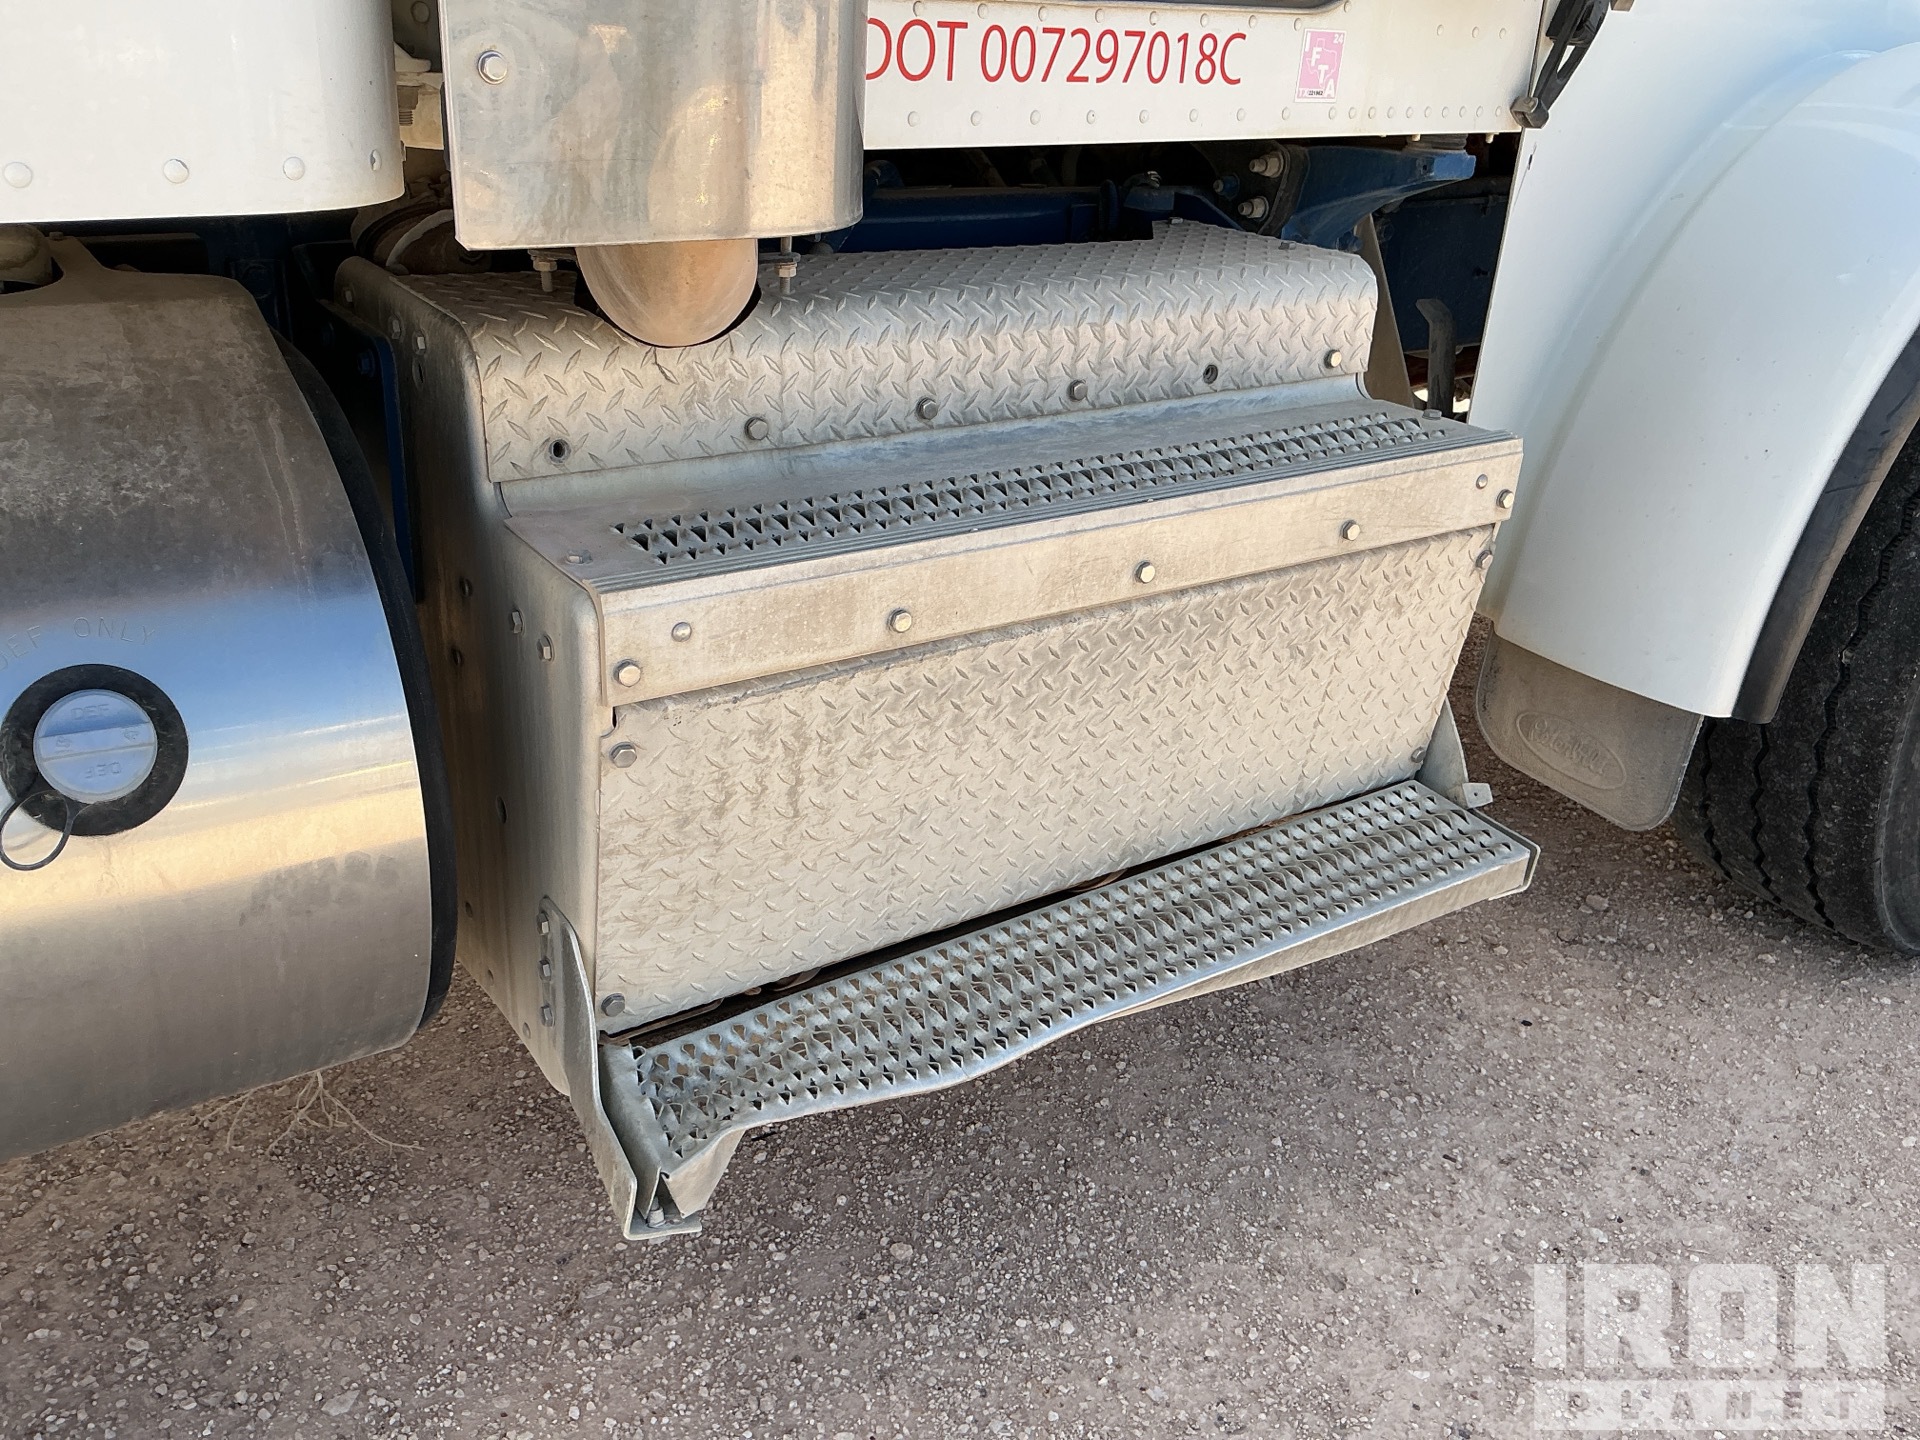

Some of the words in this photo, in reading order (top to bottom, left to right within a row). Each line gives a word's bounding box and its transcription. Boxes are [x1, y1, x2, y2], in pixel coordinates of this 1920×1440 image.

[1333, 33, 1344, 44] 24
[979, 24, 1247, 86] 007297018C
[73, 616, 156, 646] ONLY
[70, 703, 111, 721] DEF
[83, 761, 123, 780] DEF
